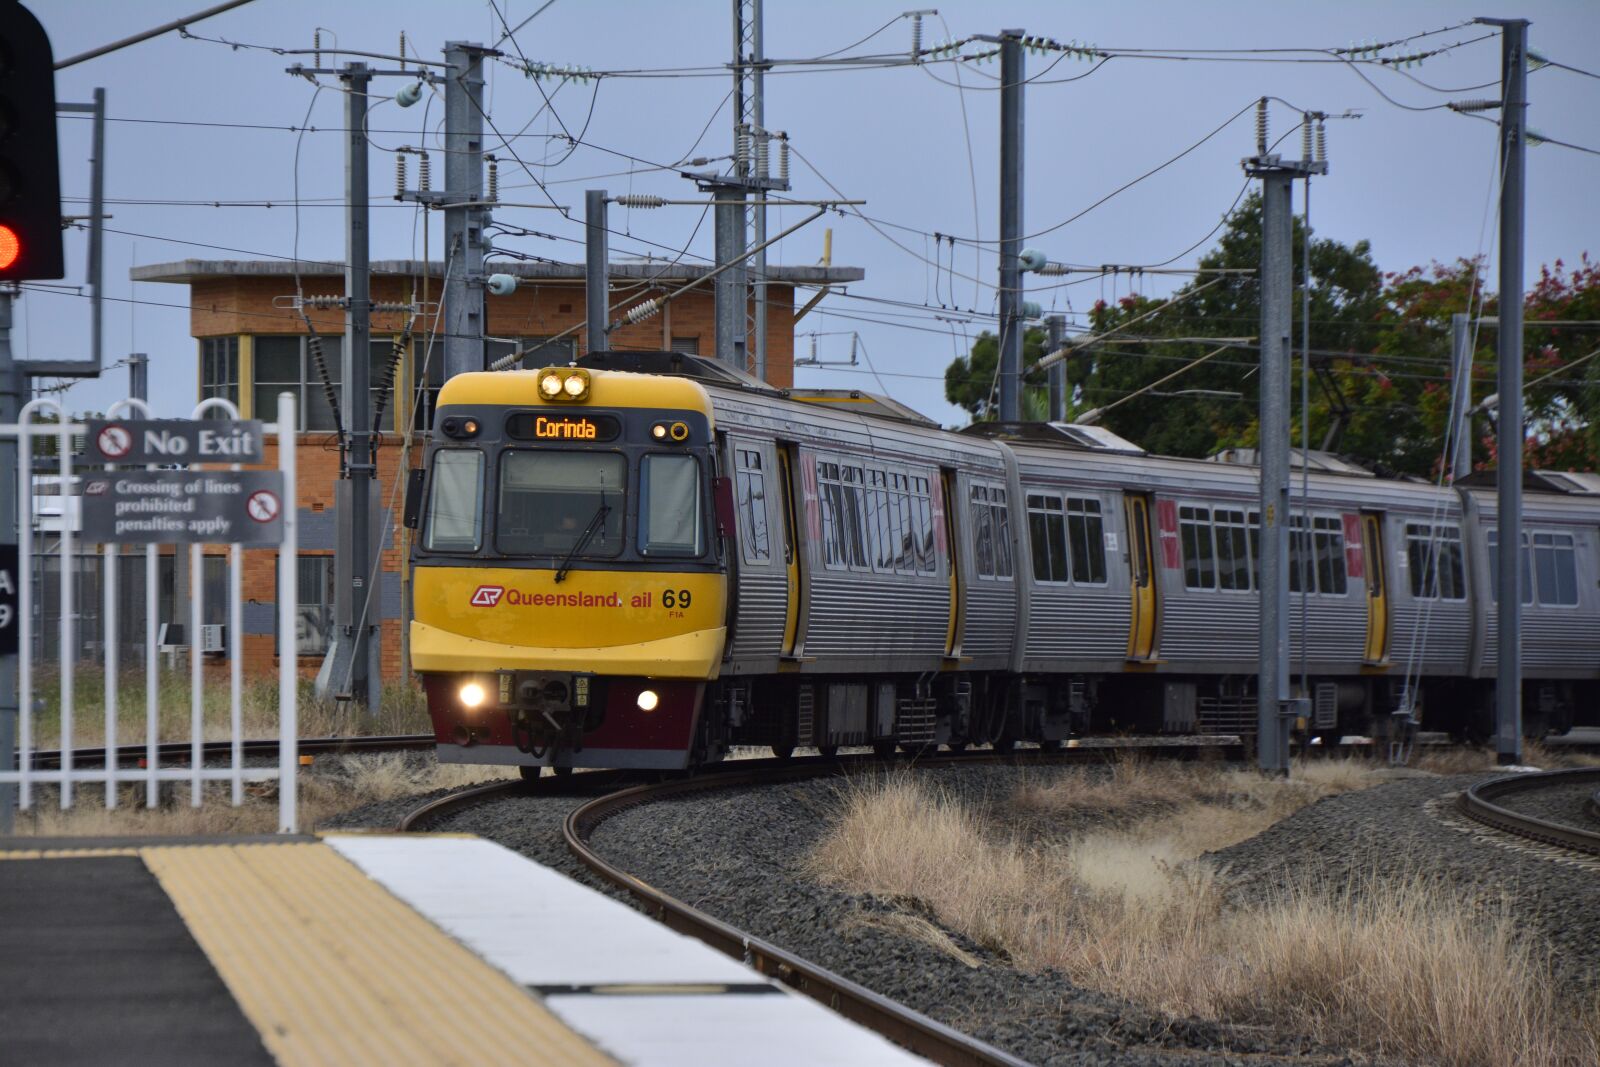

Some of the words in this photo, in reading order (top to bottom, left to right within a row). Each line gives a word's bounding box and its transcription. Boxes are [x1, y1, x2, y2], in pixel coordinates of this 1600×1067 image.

[536, 417, 596, 439] Corinda
[144, 429, 189, 455] No
[198, 428, 254, 455] Exit
[115, 479, 180, 497] Crossing
[184, 480, 202, 494] of
[205, 479, 241, 494] lines
[115, 499, 194, 516] prohibited
[115, 518, 184, 535] penalties
[188, 518, 231, 535] apply
[506, 589, 618, 608] Queensland
[662, 589, 692, 609] 69
